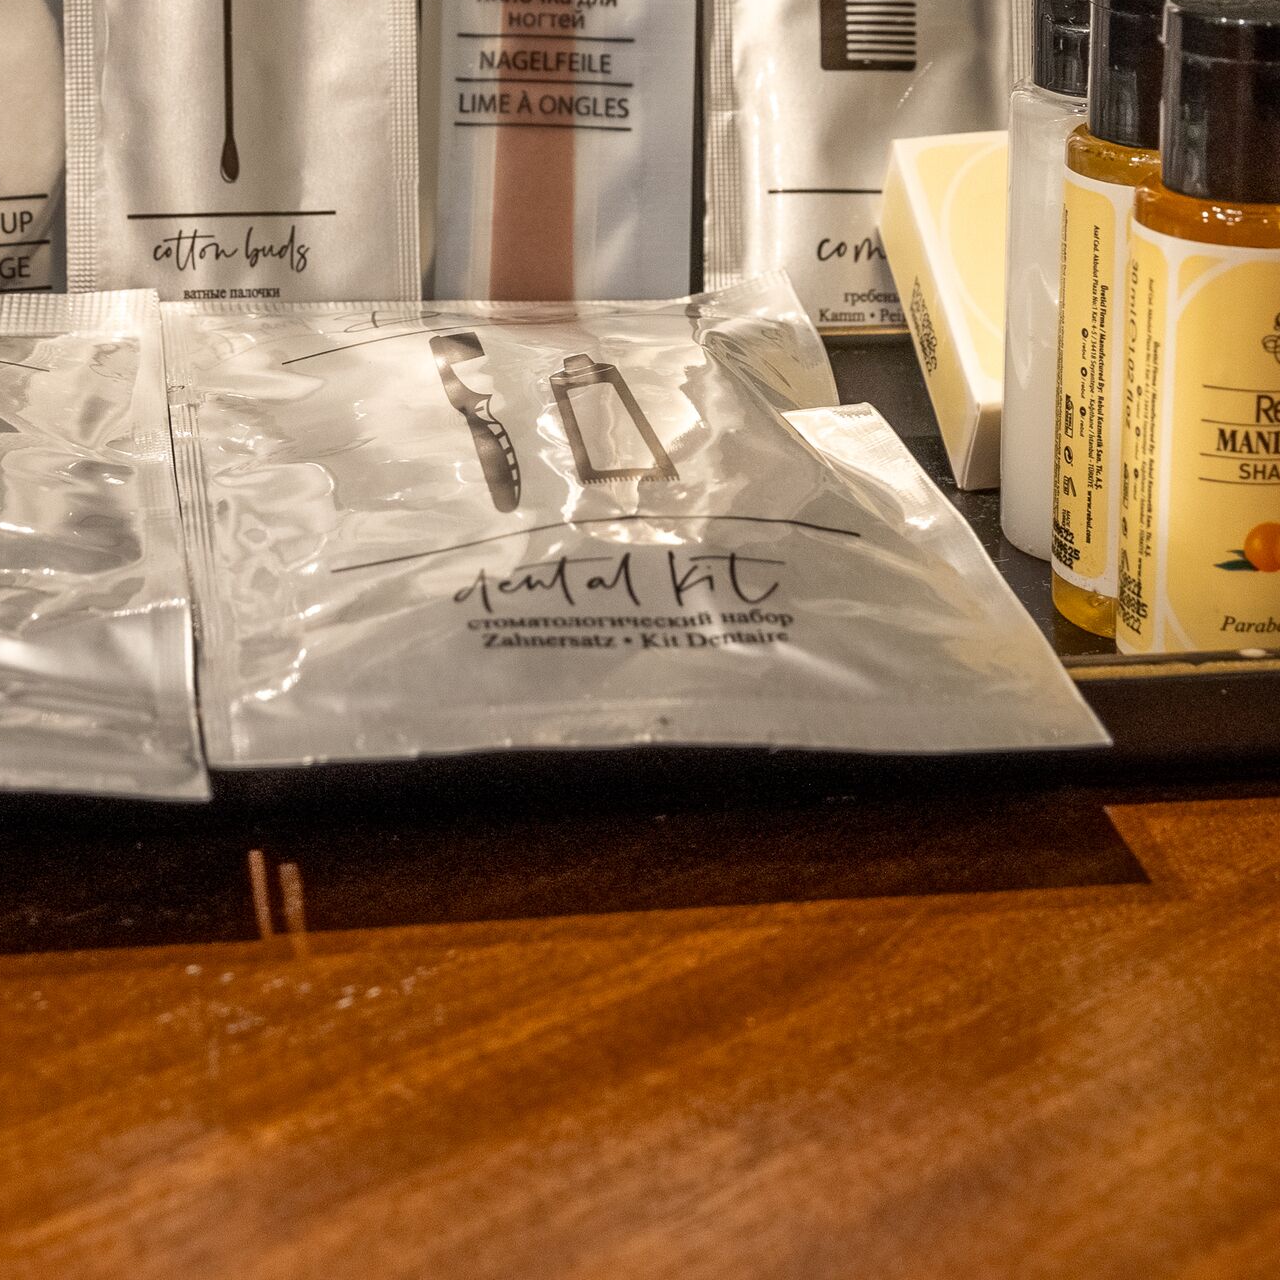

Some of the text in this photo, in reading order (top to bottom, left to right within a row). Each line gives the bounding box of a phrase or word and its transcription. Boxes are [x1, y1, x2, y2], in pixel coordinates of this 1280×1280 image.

[508, 7, 585, 30] ногтей
[479, 50, 612, 75] NAGELFEILE
[457, 88, 630, 118] LIME À ONGLES
[152, 225, 310, 272] cotton buds
[816, 237, 888, 263] com
[183, 287, 281, 299] ватные палочки
[818, 308, 866, 322] Kamm
[453, 550, 786, 614] dental kit
[719, 607, 794, 629] набор
[482, 629, 789, 649] Zahnersatz Kit Dentaire
